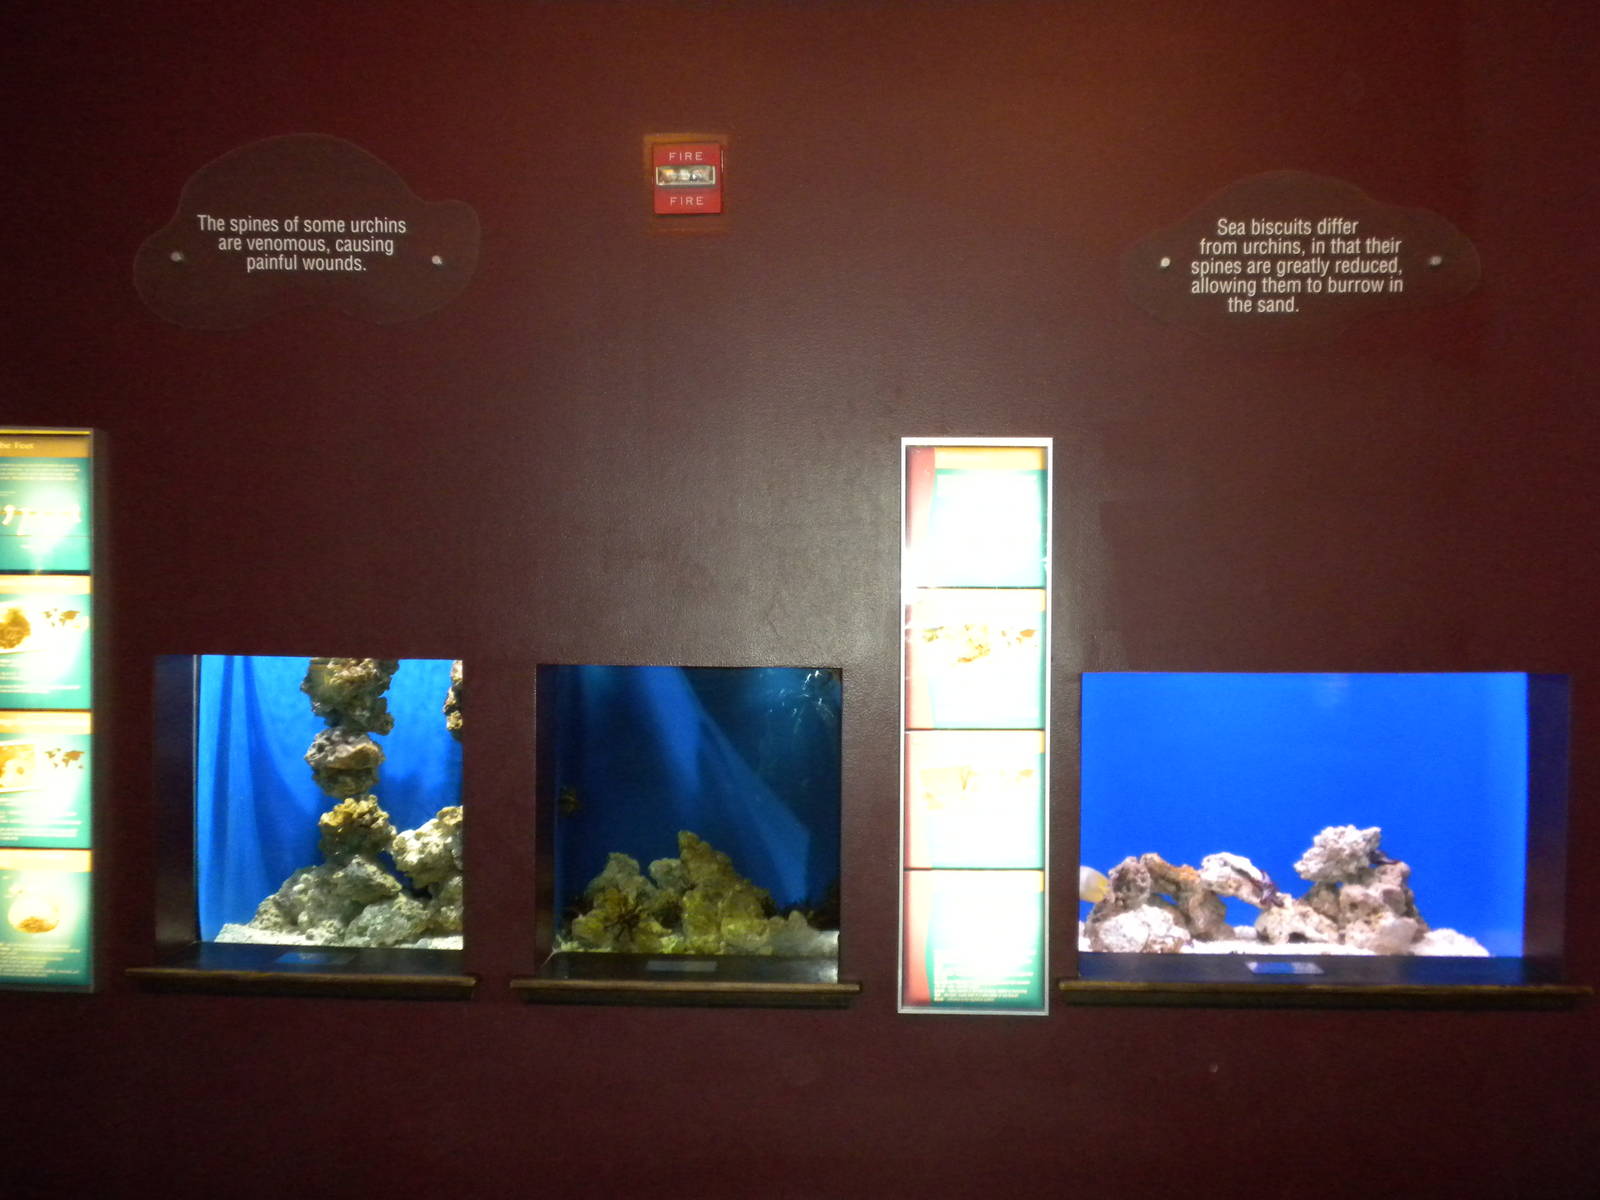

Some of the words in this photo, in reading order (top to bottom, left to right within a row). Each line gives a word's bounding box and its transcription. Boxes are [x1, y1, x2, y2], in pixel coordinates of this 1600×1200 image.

[669, 151, 704, 161] FIRE
[670, 196, 704, 206] FIRE
[197, 215, 225, 232] The
[230, 216, 279, 235] spines
[284, 216, 300, 233] of
[304, 219, 345, 233] some
[351, 217, 407, 234] urchins
[1217, 218, 1246, 236] Sea
[1251, 218, 1312, 235] biscuits
[1317, 218, 1359, 235] differ
[218, 239, 242, 251] are
[247, 238, 331, 254] venomous,
[335, 236, 394, 256] causing
[1200, 238, 1237, 255] from
[1243, 238, 1306, 257] urchins,
[1311, 238, 1326, 254] in
[1330, 238, 1361, 254] that
[1365, 238, 1402, 254] their
[247, 254, 298, 273] painful
[302, 254, 367, 271] wounds.
[1191, 258, 1242, 277] spines
[1247, 261, 1271, 275] are
[1276, 258, 1331, 277] greatly
[1335, 257, 1403, 275] reduced,
[1191, 277, 1257, 297] allowing
[1261, 277, 1301, 294] them
[1306, 278, 1322, 293] to
[1328, 277, 1384, 293] burrow
[1388, 277, 1403, 292] in
[1228, 297, 1253, 313] the
[1257, 297, 1300, 313] sand.
